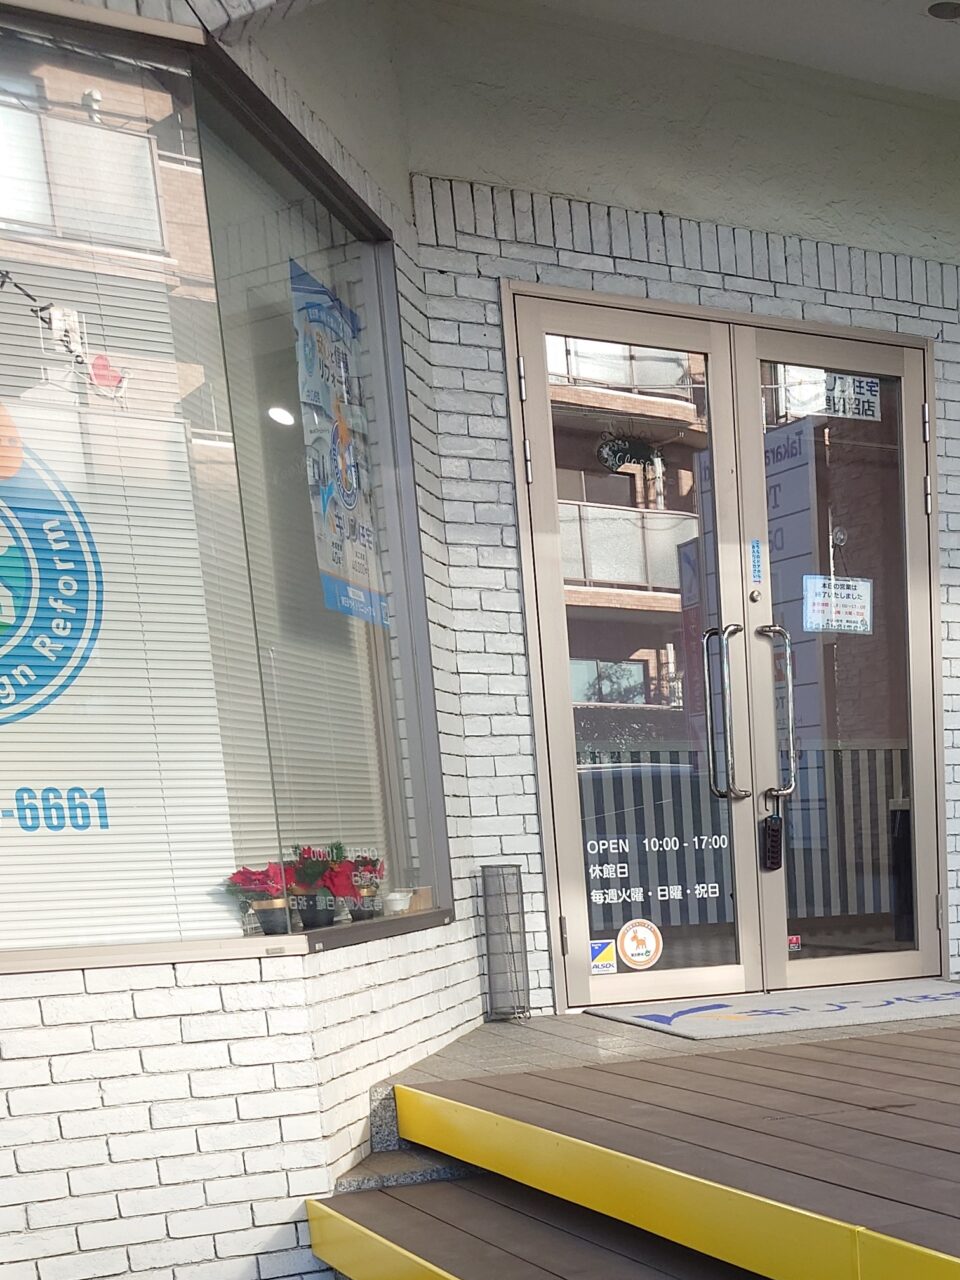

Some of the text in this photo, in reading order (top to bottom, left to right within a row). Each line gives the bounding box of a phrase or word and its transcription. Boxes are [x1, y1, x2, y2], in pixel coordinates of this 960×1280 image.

[32, 519, 78, 662] Reform
[587, 839, 629, 854] OPEN
[643, 837, 679, 852] 10:00
[693, 835, 728, 850] 17:00
[589, 863, 629, 879] 休館日
[590, 883, 720, 905] 毎週火曜・日曜・祝日
